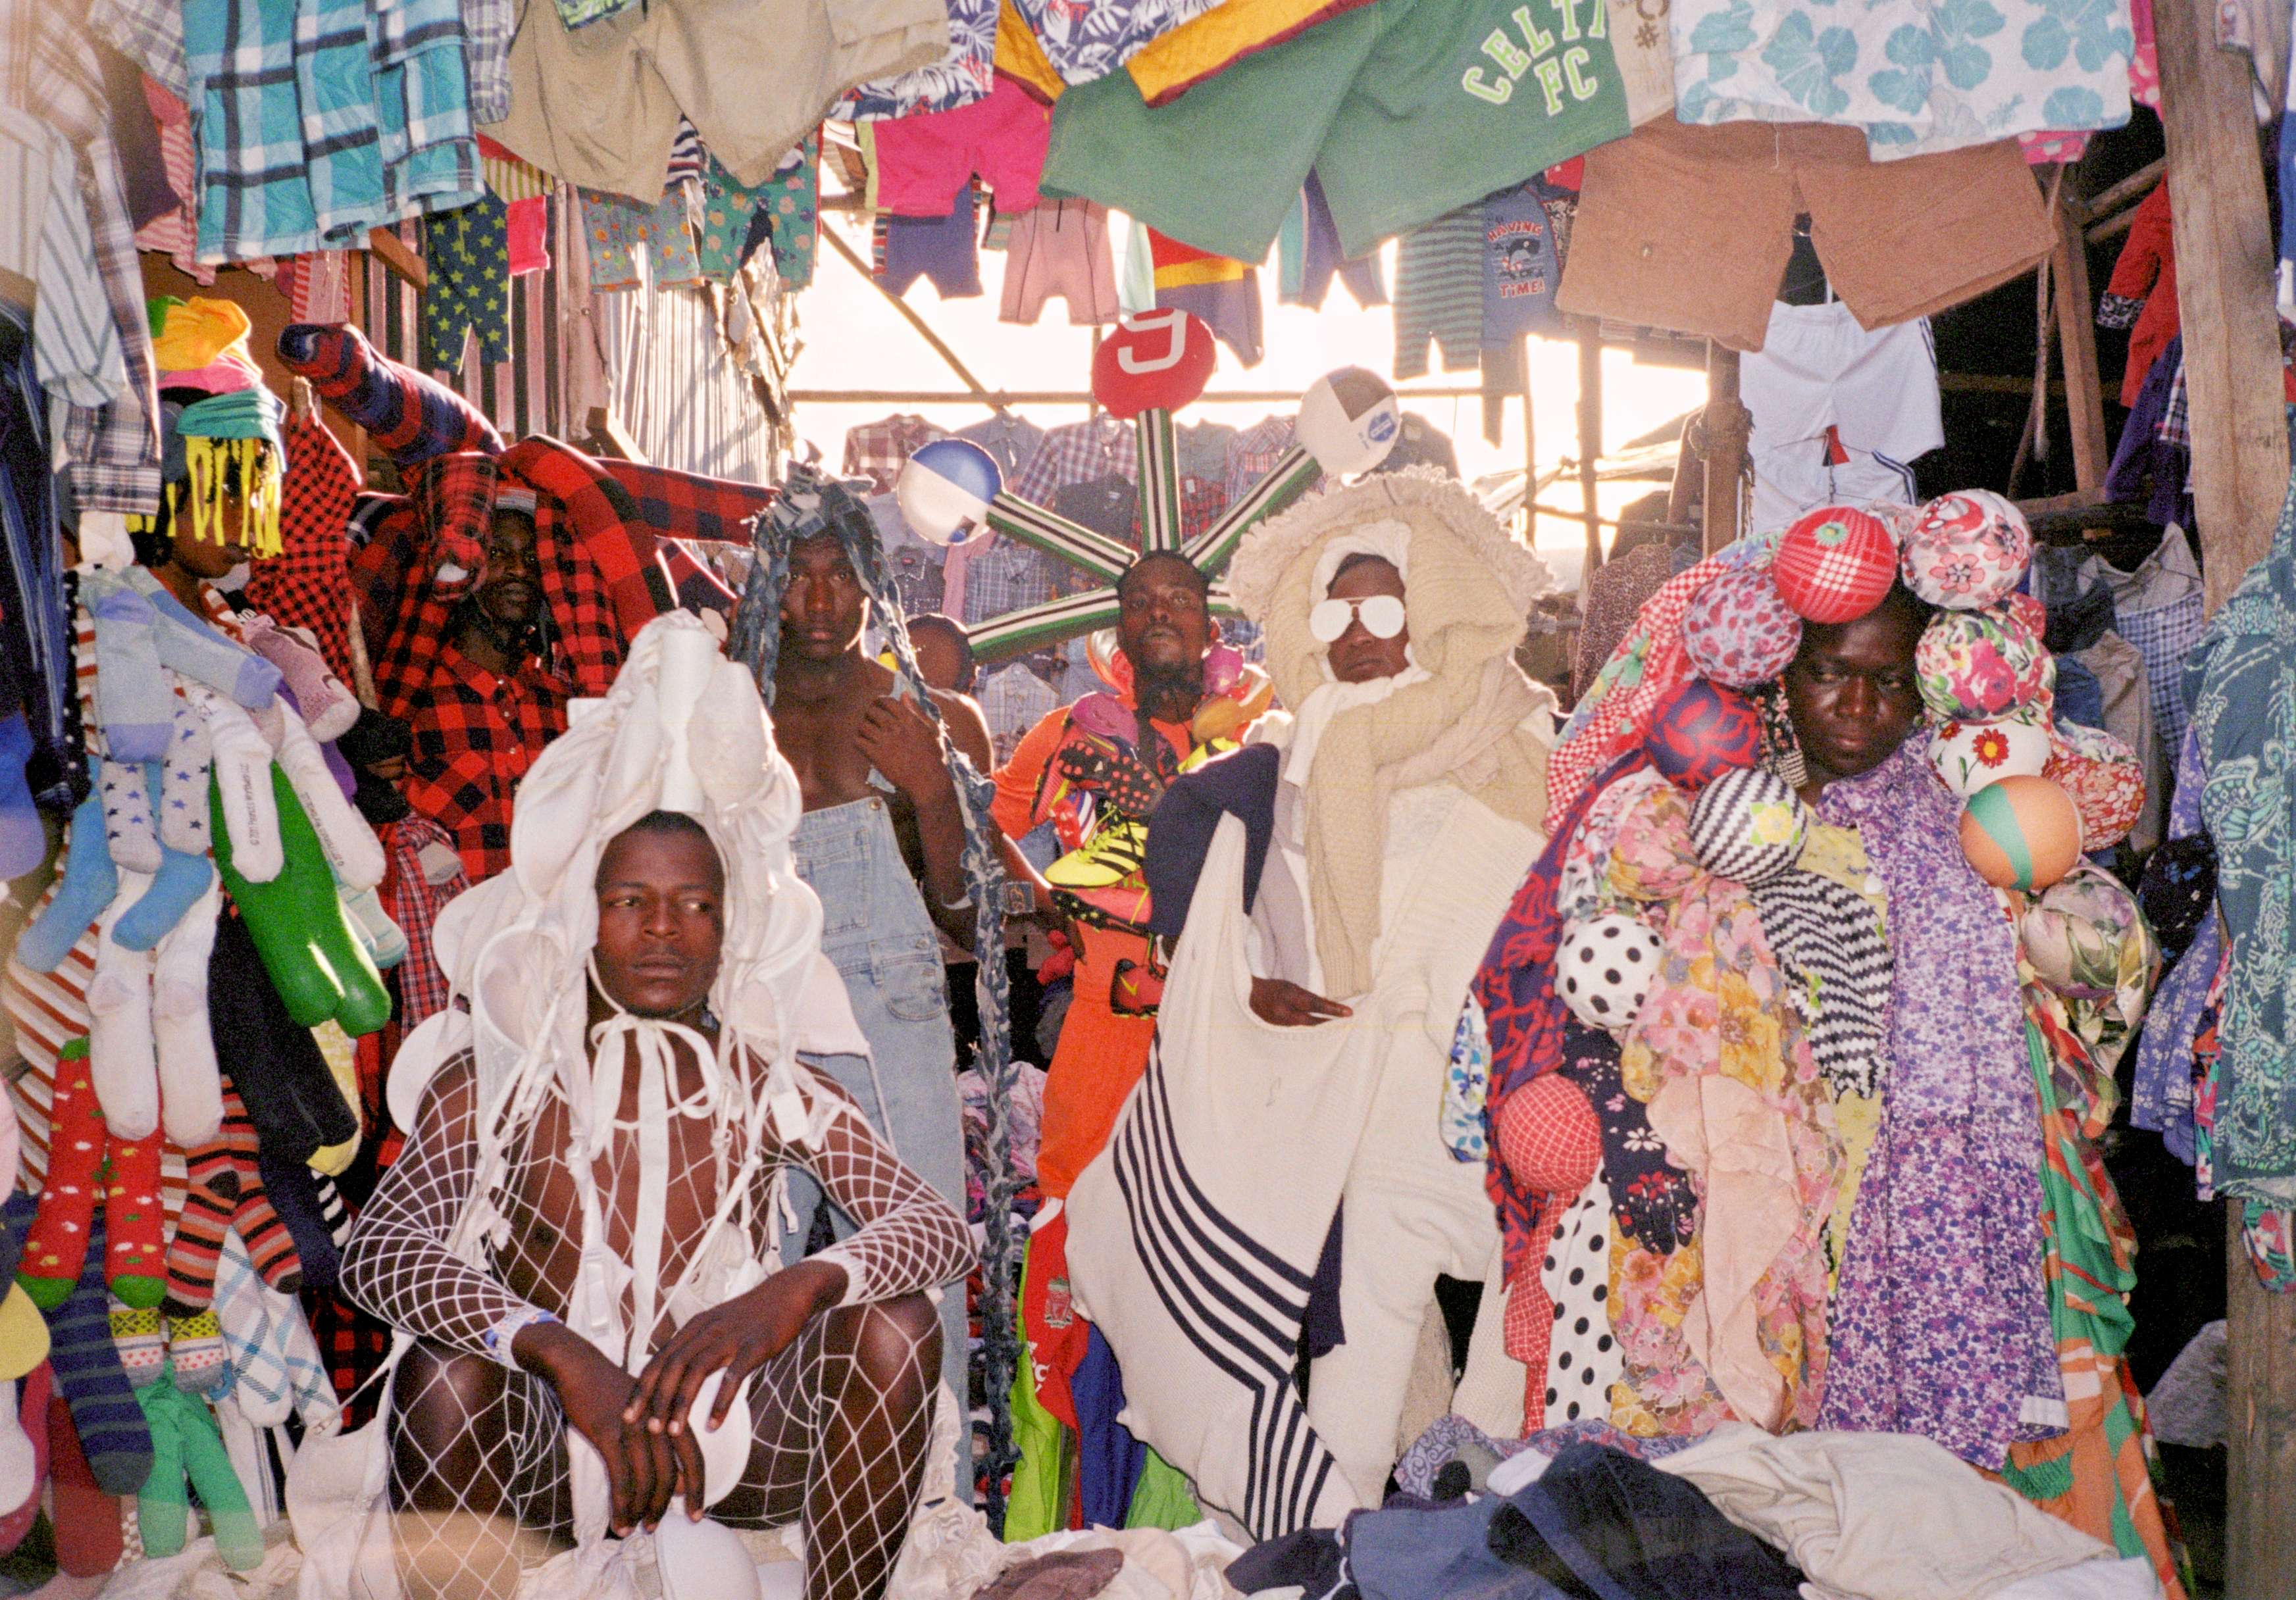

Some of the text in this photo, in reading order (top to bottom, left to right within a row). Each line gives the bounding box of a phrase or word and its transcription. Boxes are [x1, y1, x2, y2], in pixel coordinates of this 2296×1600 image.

[1533, 46, 1598, 116] FC
[1487, 220, 1543, 242] HAVING
[1499, 278, 1545, 298] TIME!
